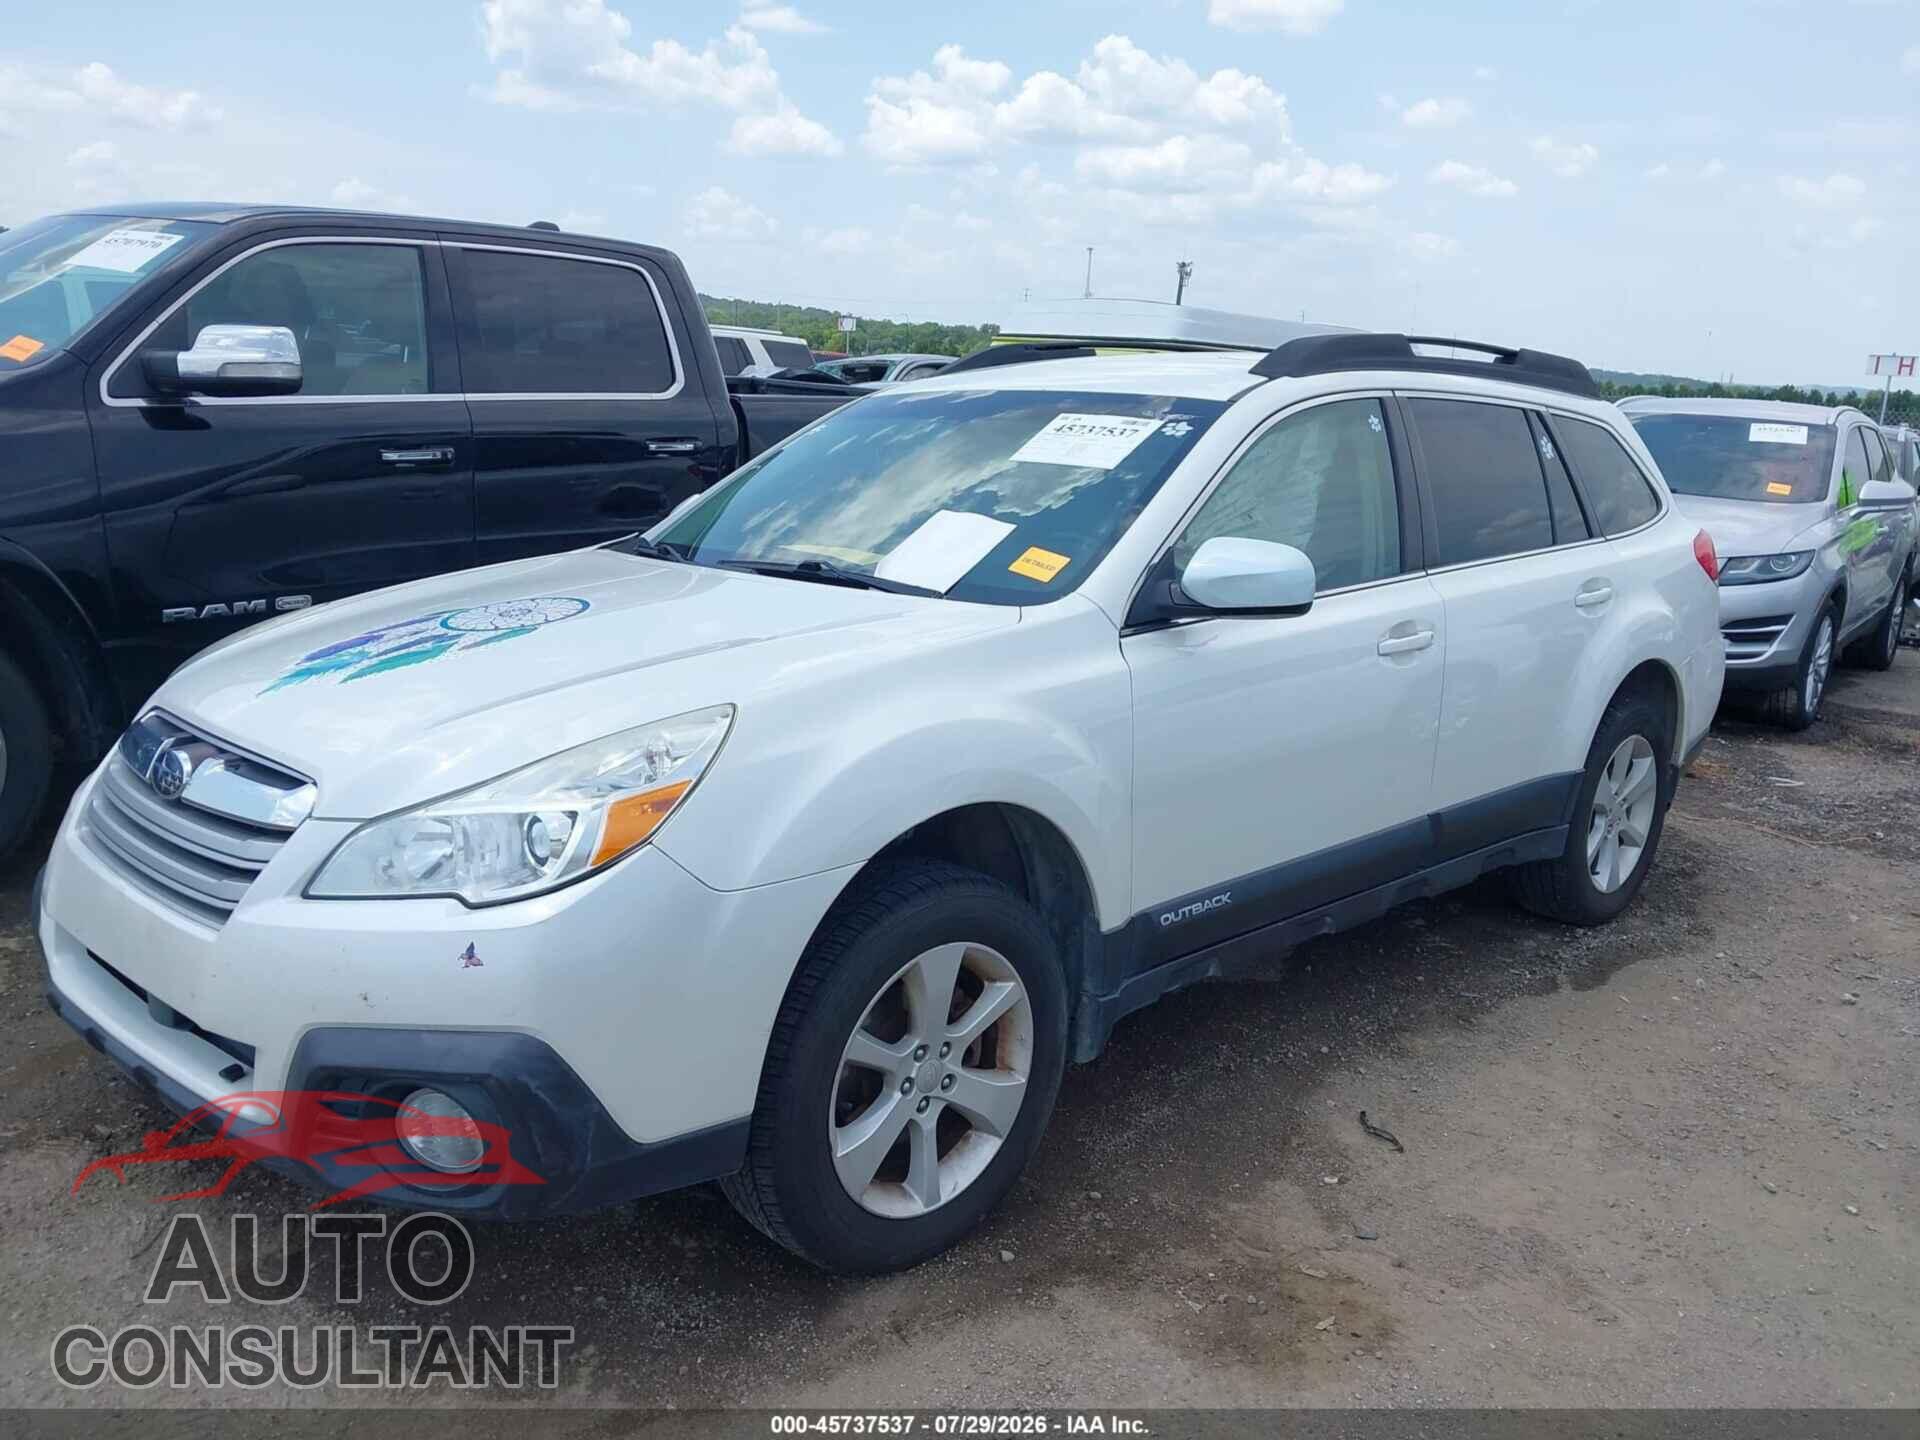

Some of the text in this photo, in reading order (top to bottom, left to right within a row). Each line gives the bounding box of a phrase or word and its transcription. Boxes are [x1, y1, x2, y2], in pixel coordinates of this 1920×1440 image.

[1898, 356, 1916, 376] H
[1053, 424, 1140, 438] 45737537
[162, 599, 267, 623] RAM
[1160, 892, 1232, 926] OUTBACK
